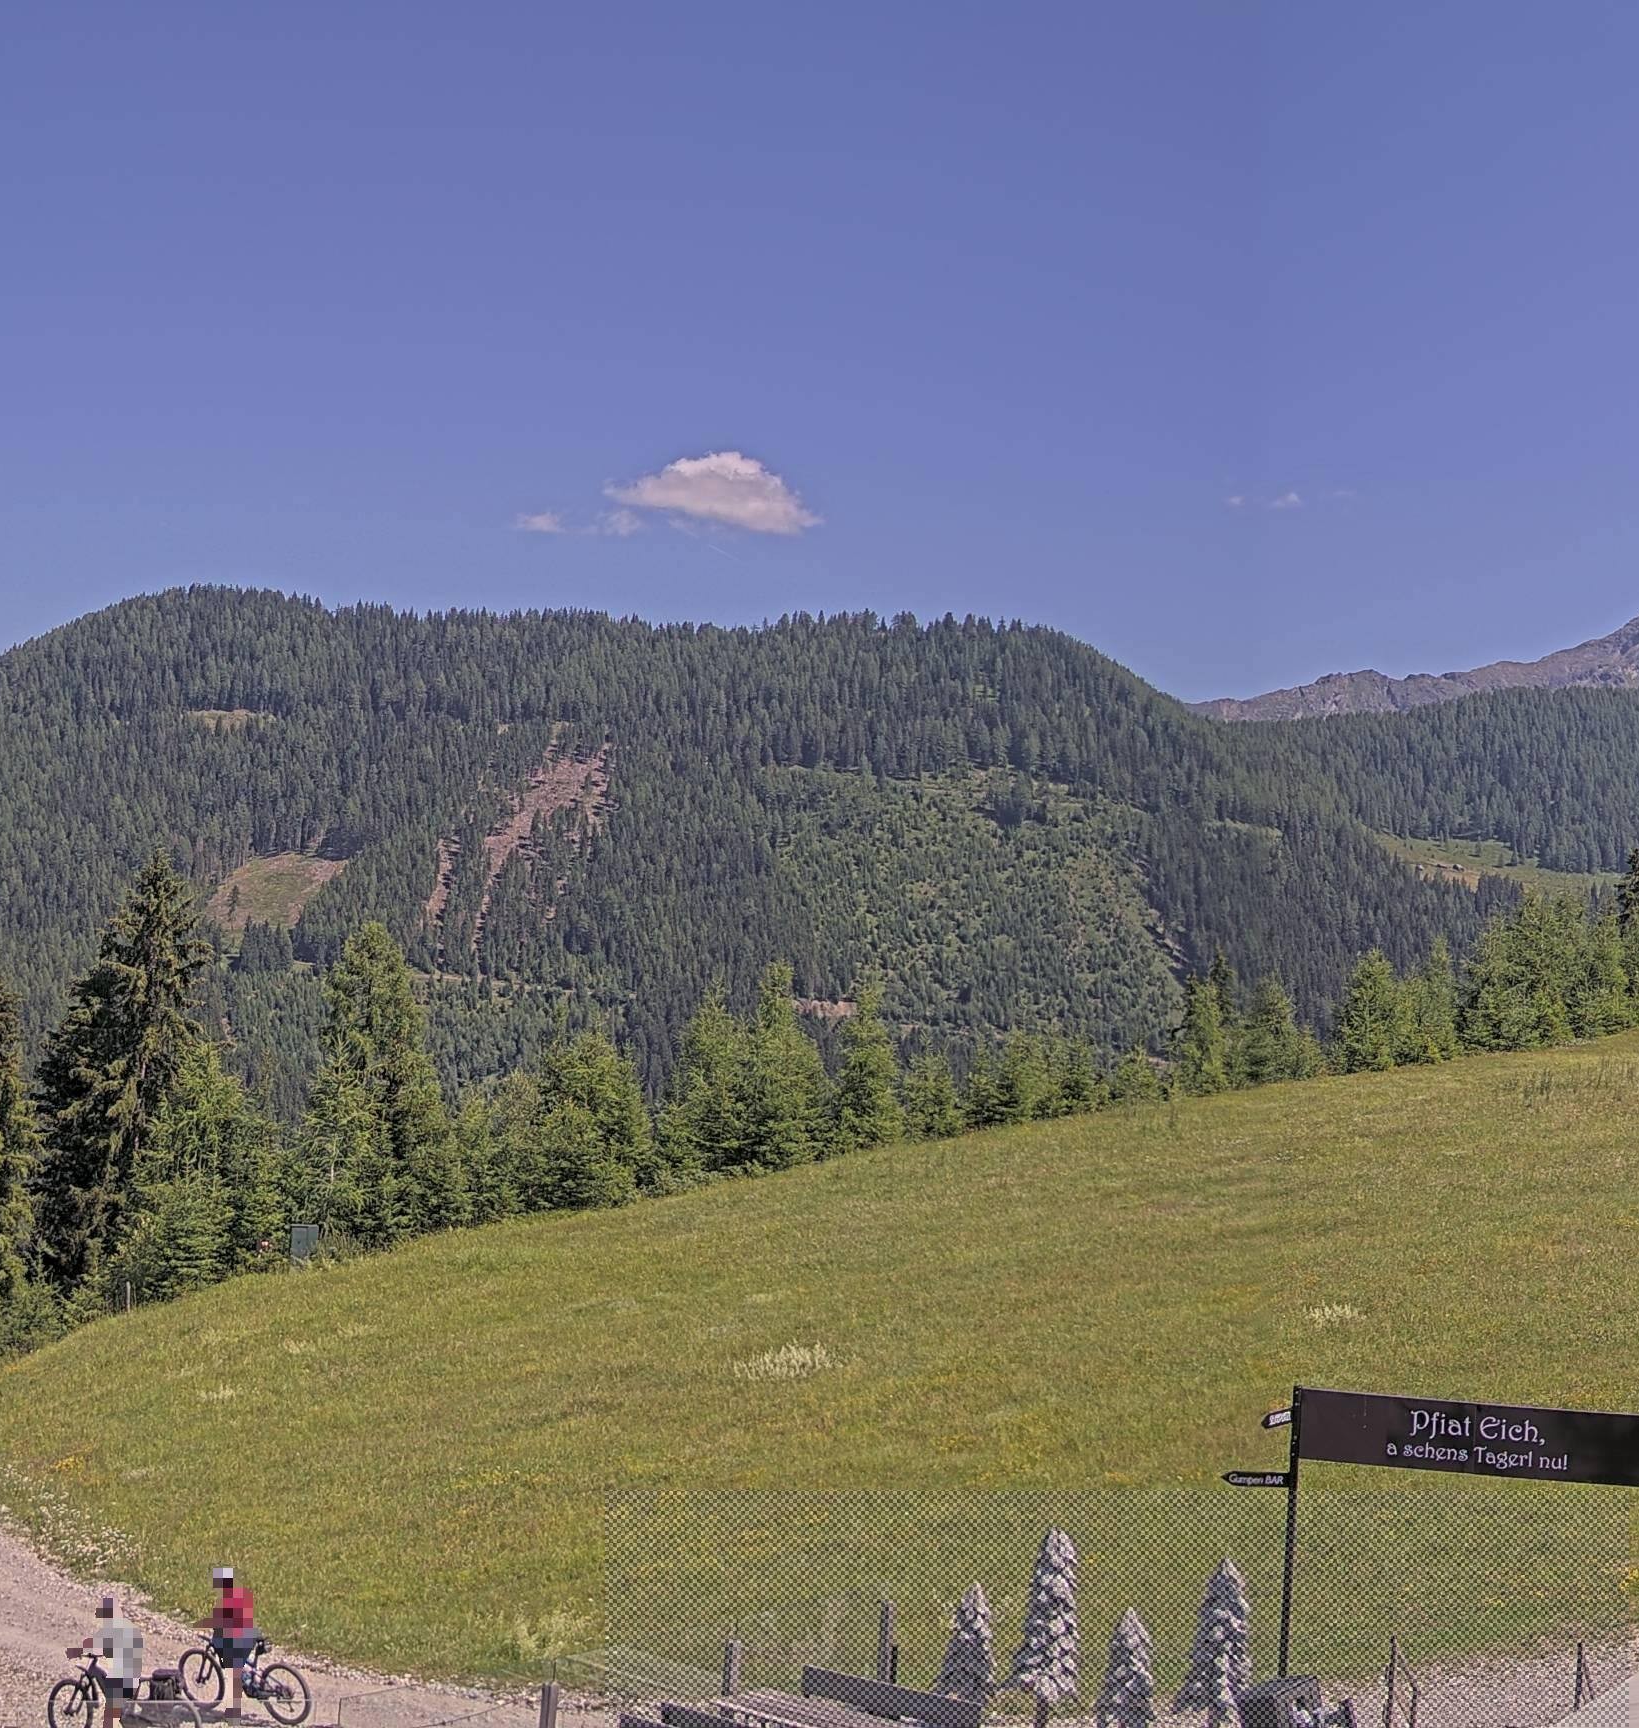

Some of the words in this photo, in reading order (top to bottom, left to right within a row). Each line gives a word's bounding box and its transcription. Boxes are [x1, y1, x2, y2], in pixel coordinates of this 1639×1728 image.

[1410, 1410, 1471, 1439] Pfiat
[1479, 1416, 1546, 1446] Eich,
[1387, 1443, 1398, 1456] a
[1403, 1442, 1469, 1462] schens
[1473, 1446, 1533, 1470] Tagerl
[1539, 1454, 1568, 1471] nu!
[1265, 1475, 1284, 1485] BAR
